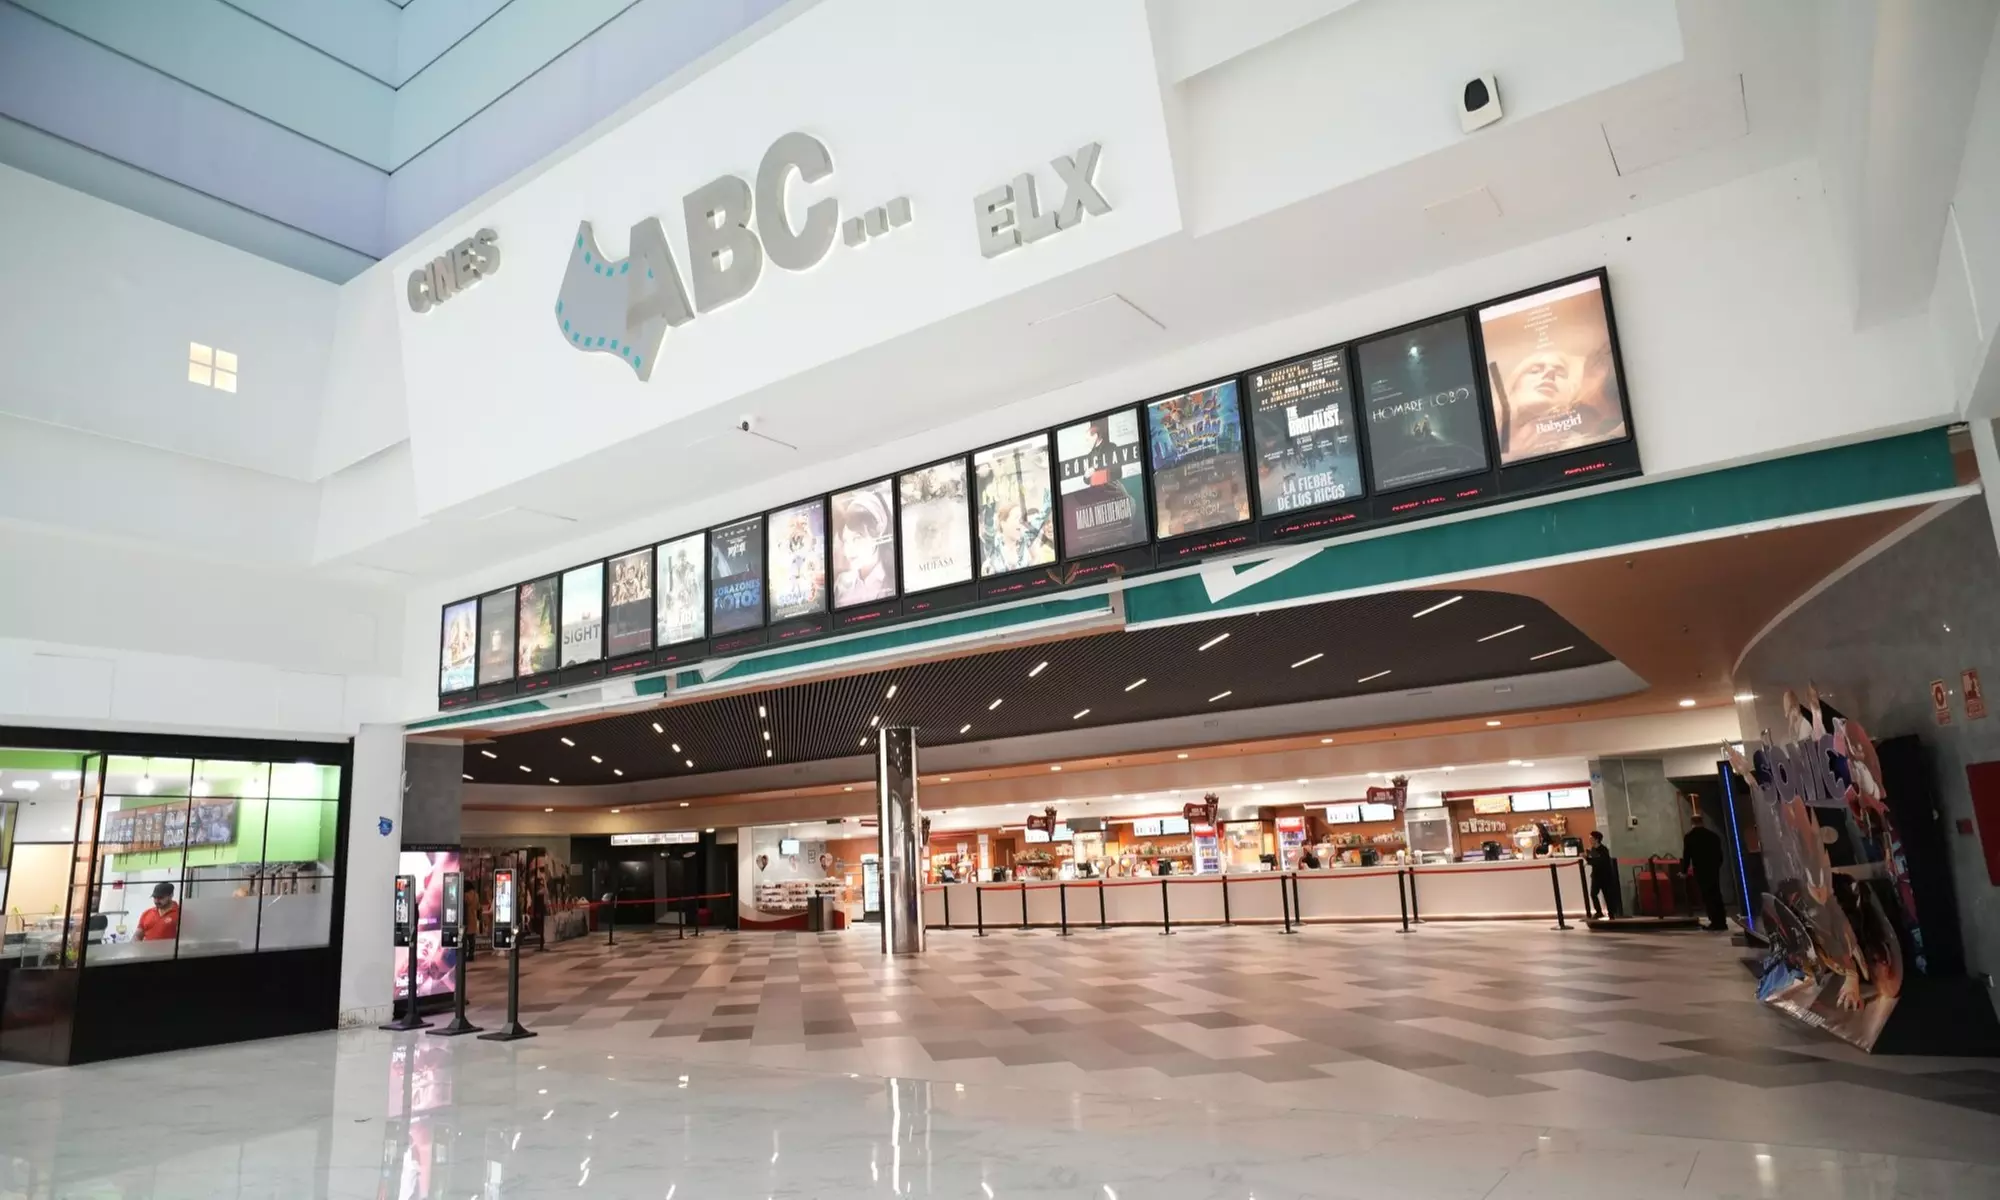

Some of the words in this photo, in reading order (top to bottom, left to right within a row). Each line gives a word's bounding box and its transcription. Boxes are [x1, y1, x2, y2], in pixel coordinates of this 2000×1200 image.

[407, 228, 501, 314] CINES
[973, 141, 1112, 259] ELX
[1372, 398, 1423, 423] HOMBRE
[1430, 387, 1470, 407] LOBO
[1288, 411, 1340, 437] BRUTALIST
[1535, 413, 1583, 435] Babygirl
[1064, 447, 1140, 476] CÓNCLAVE
[1283, 481, 1296, 493] LA
[1298, 472, 1334, 489] FIEBRE
[1277, 496, 1290, 510] DE
[1293, 490, 1312, 508] LOS
[1315, 484, 1346, 503] RICOS
[1075, 508, 1094, 530] MALA
[918, 557, 954, 572] MUFASA
[714, 580, 760, 596] CORAZONES
[563, 623, 601, 646] SIGHT
[1753, 733, 1847, 806] SONIC
